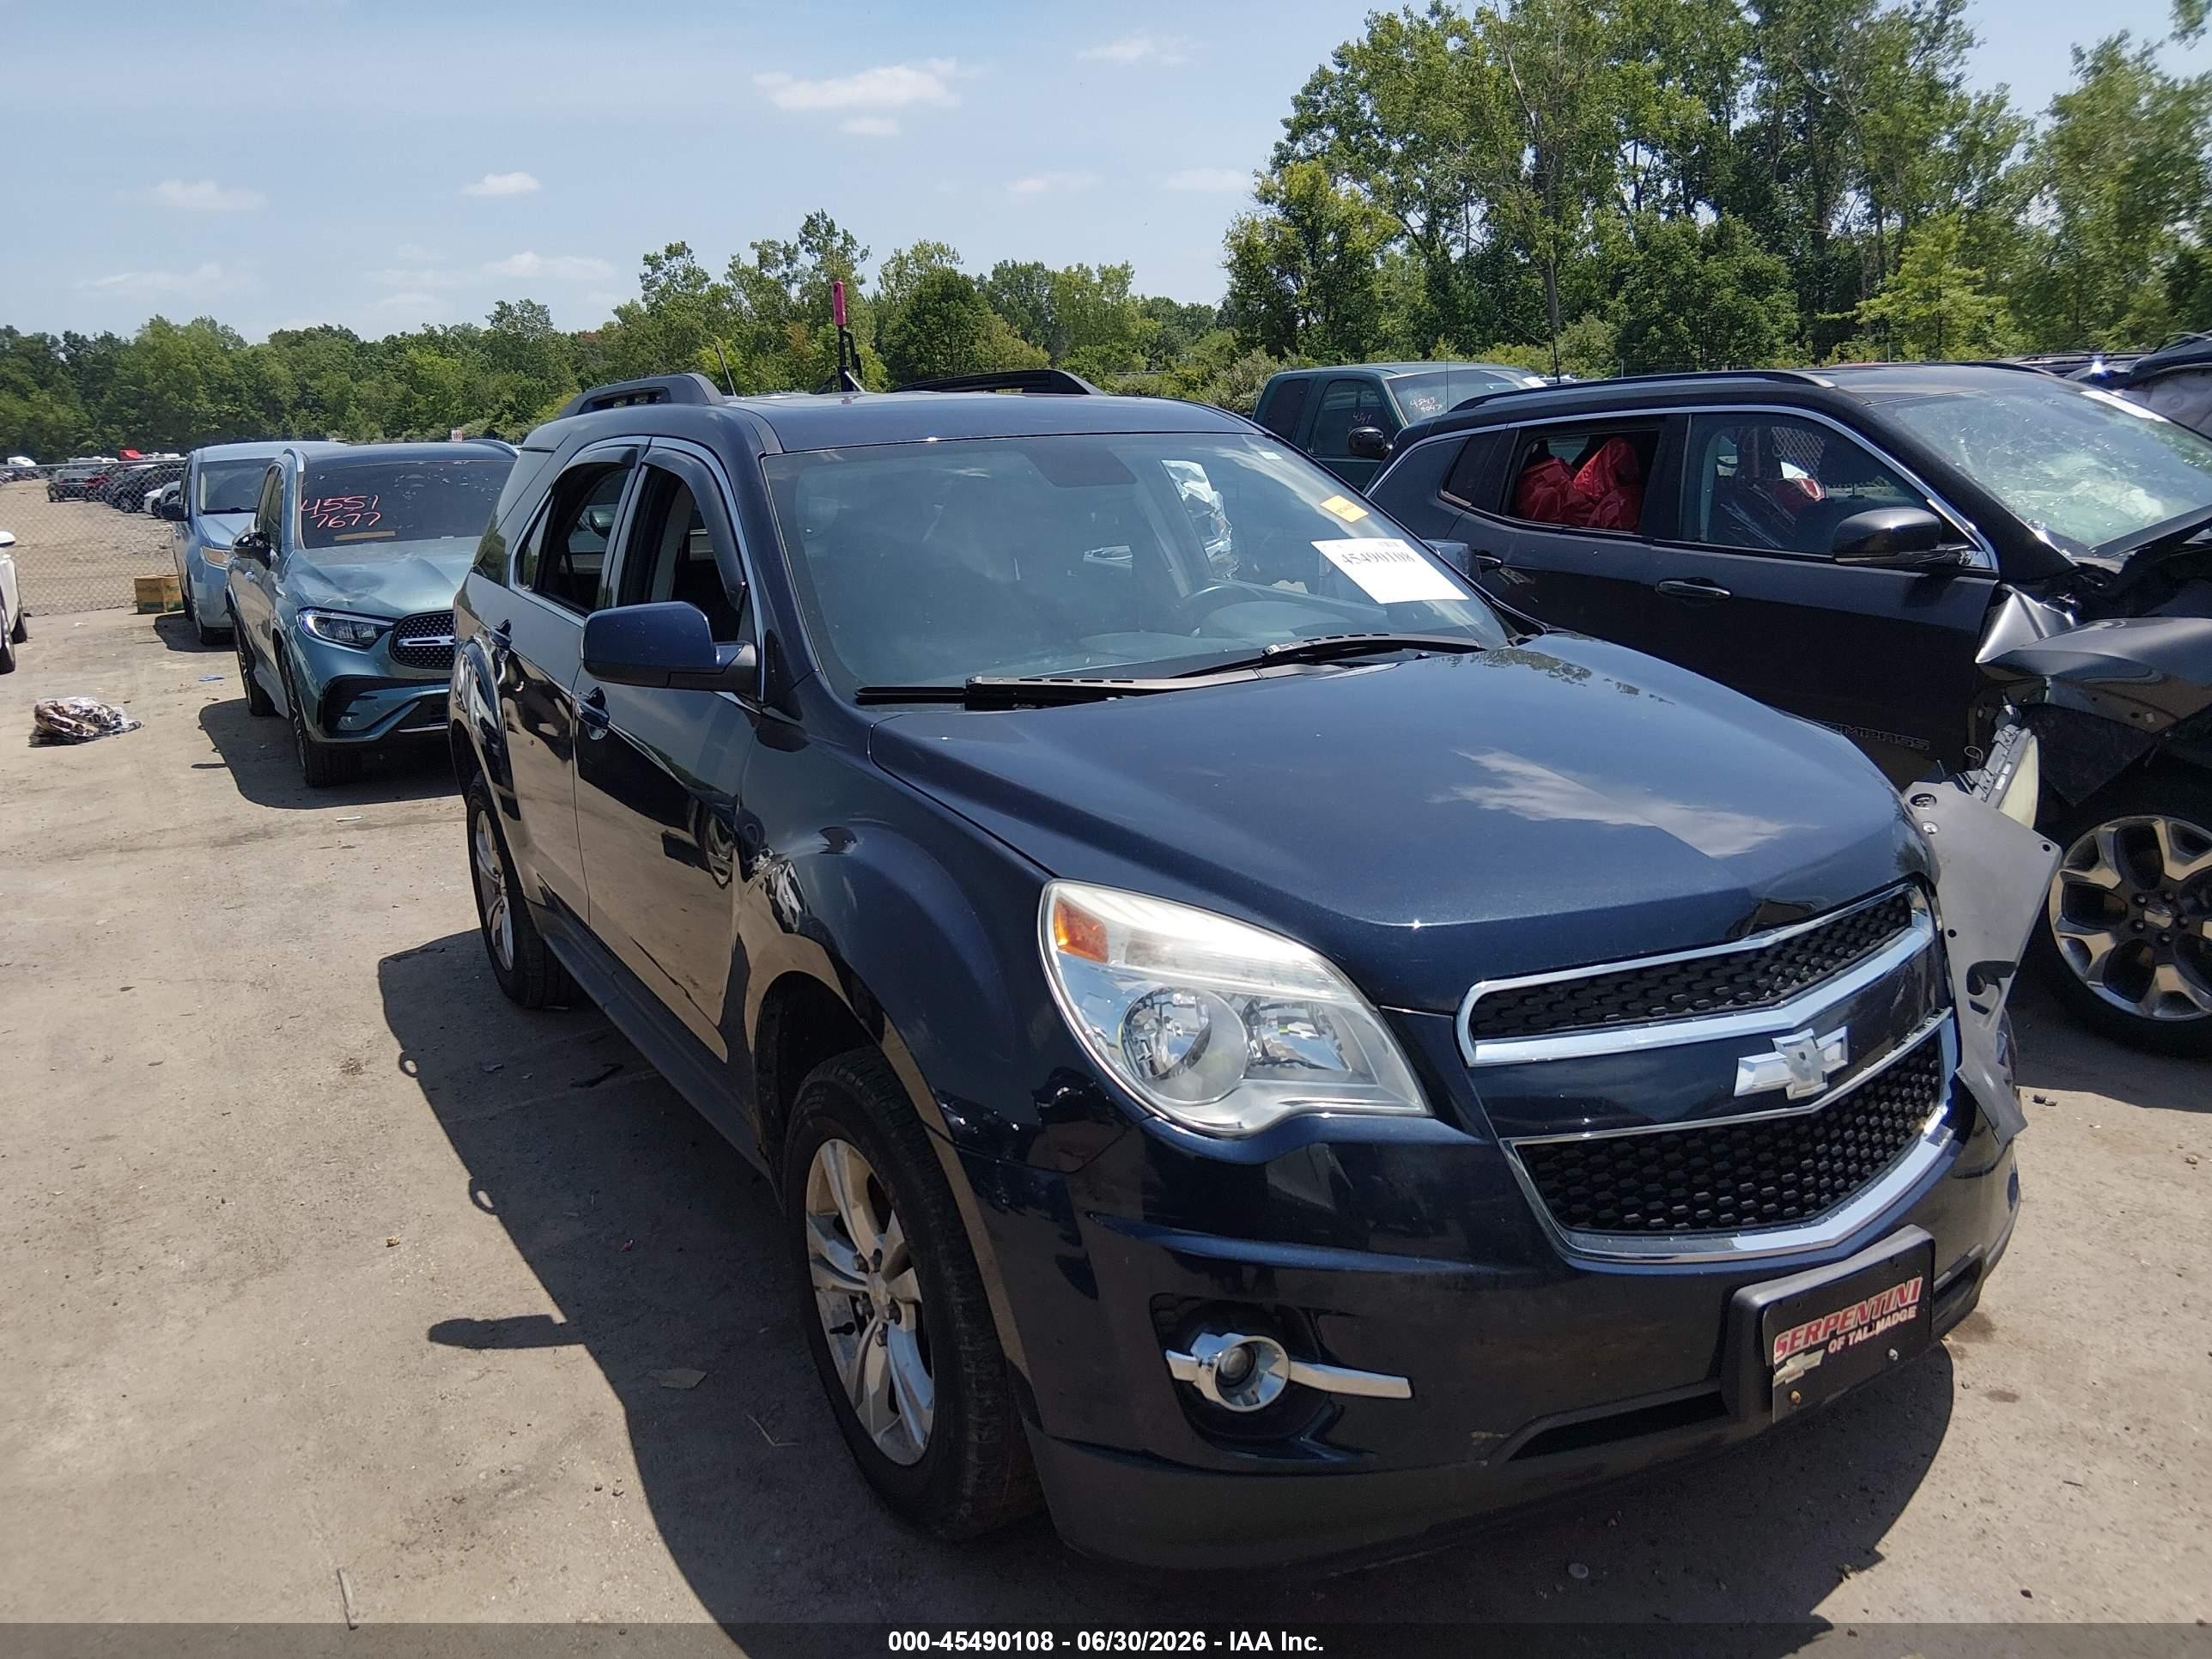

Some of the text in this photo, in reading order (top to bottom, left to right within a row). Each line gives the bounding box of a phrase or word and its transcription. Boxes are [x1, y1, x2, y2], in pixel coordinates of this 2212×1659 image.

[301, 495, 379, 515] 4551
[309, 512, 381, 528] 7677
[1824, 722, 1930, 751] MPASS
[1773, 1277, 1923, 1364] SERPENTINI
[1827, 1336, 1845, 1354] OF
